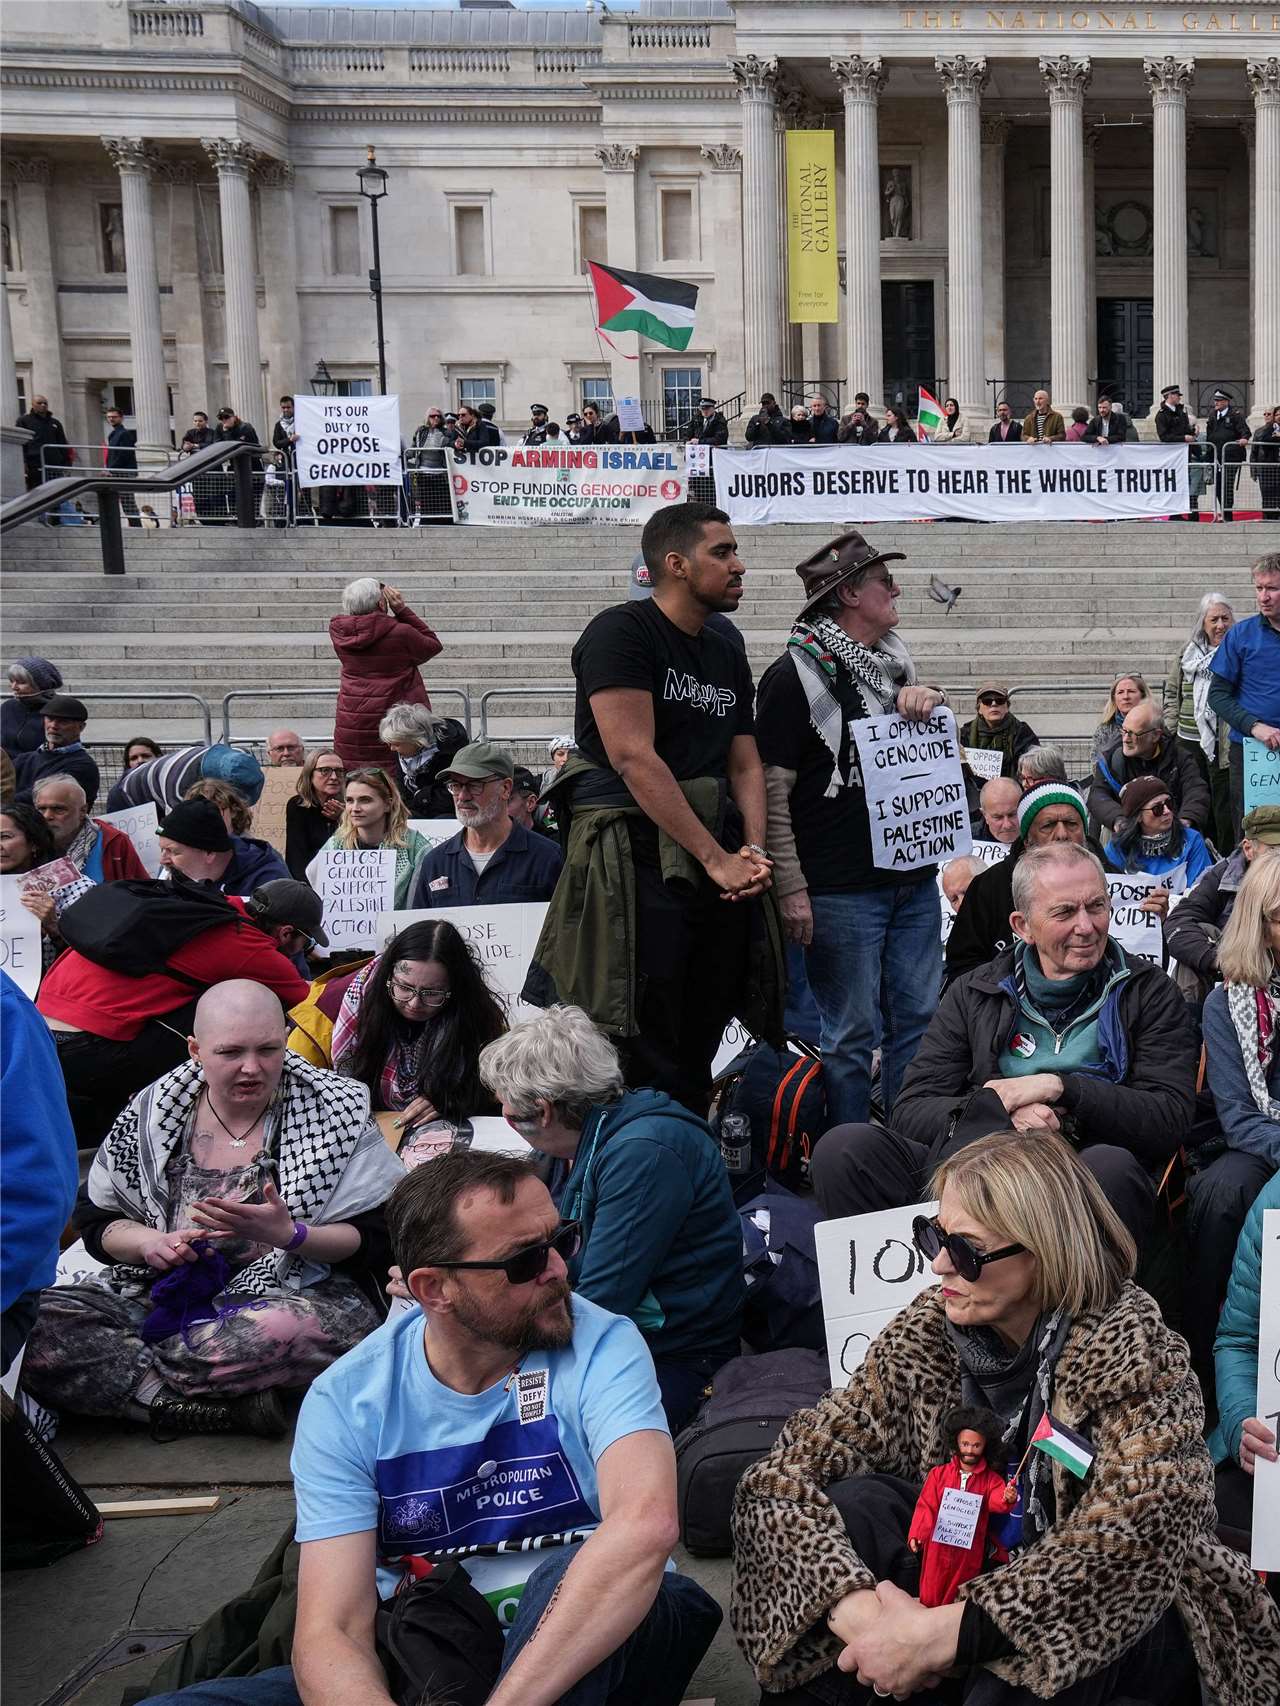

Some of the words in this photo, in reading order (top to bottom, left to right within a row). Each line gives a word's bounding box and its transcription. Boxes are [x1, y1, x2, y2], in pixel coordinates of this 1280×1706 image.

[901, 9, 963, 29] THE
[986, 9, 1158, 30] NATIONAL
[800, 161, 814, 252] NATIONAL
[814, 163, 830, 253] GALLERY
[324, 406, 342, 417] IT'S
[345, 406, 369, 417] OUR
[325, 423, 352, 433] DUTY
[356, 423, 370, 434] TO
[317, 437, 380, 455] OPPOSE
[453, 448, 508, 466] STOP
[511, 450, 598, 470] ARMING
[602, 451, 678, 471] ISRAEL
[309, 462, 391, 480] GENOCIDE
[470, 481, 510, 495] STOP
[513, 483, 577, 497] FUNDING
[581, 484, 657, 498] GENOCIDE
[728, 471, 805, 498] JURORS
[813, 470, 900, 495] DESERVE
[906, 469, 931, 493] TO
[938, 469, 989, 494] HEAR
[998, 469, 1031, 494] THE
[1038, 469, 1108, 493] WHOLE
[1114, 468, 1178, 493] TRUTH
[493, 495, 520, 507] END
[523, 496, 547, 508] THE
[549, 497, 631, 509] OCCUPATION
[867, 725, 881, 742] I
[888, 715, 949, 740] OPPOSE
[874, 739, 956, 769] GENOCIDE
[1250, 751, 1258, 762] I
[972, 764, 1001, 774] NOCIDE
[875, 800, 888, 821] I
[891, 783, 963, 818] SUPPORT
[883, 810, 965, 848] PALESTINE
[324, 852, 330, 865] I
[332, 851, 390, 865] OPPOSE
[892, 833, 956, 867] ACTION
[328, 866, 385, 880] GENOCIDE
[322, 882, 326, 896] I
[331, 880, 387, 895] SUPPORT
[521, 1375, 543, 1388] RESIST
[522, 1390, 542, 1403] DEFY
[532, 1402, 542, 1410] NOT
[455, 1464, 553, 1503] METROPOLITAN
[475, 1487, 544, 1510] POLICE
[938, 1533, 969, 1546] ACTION
